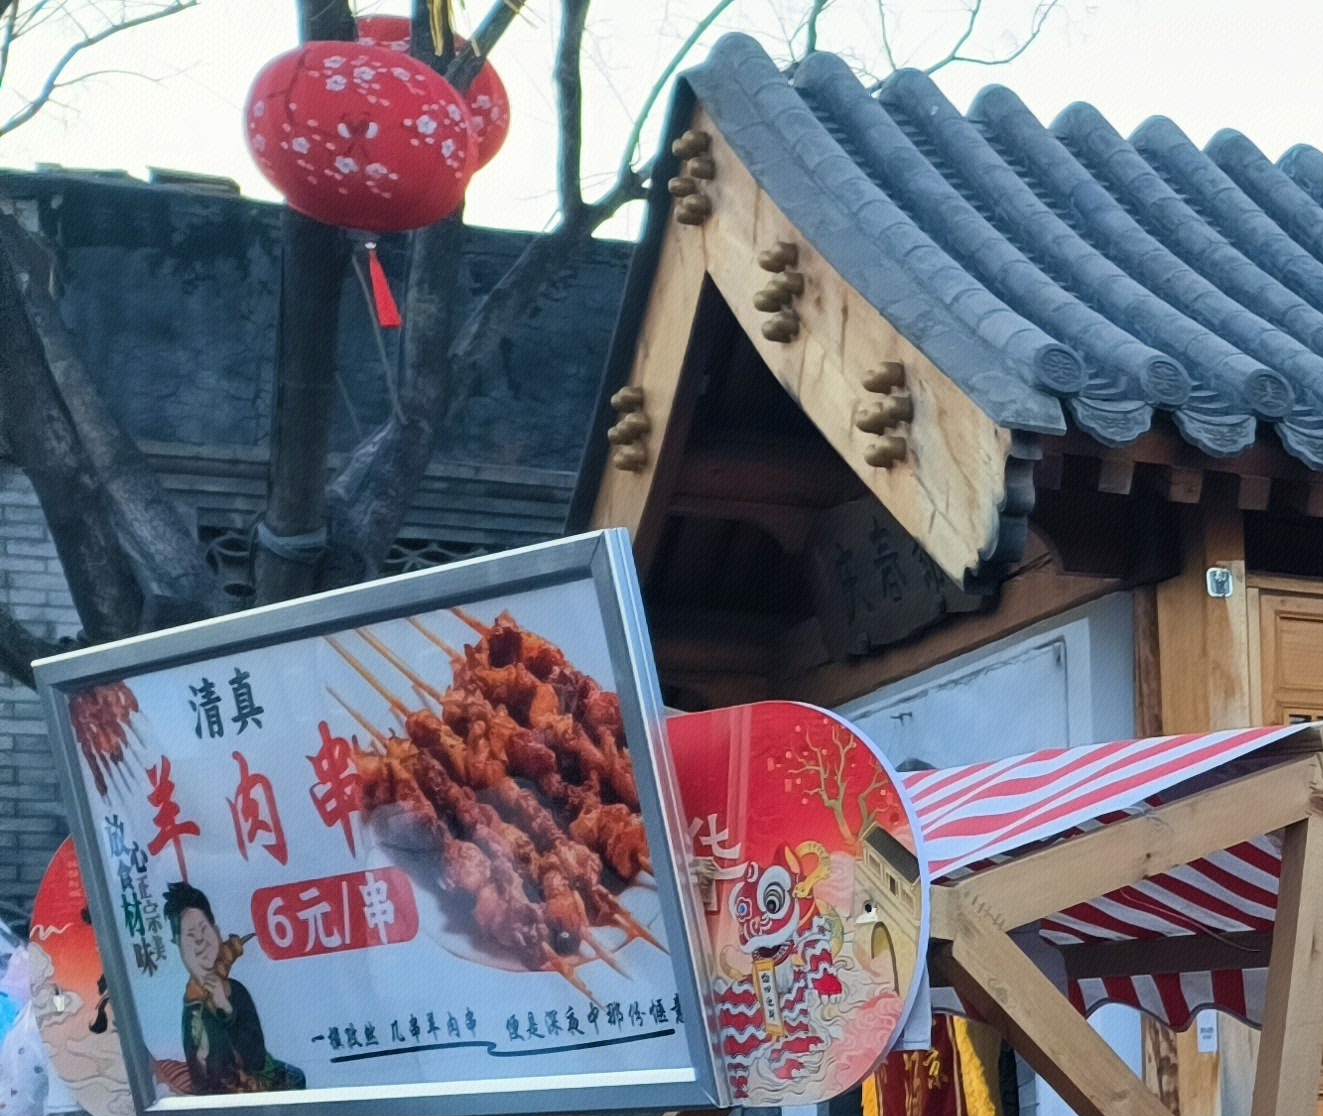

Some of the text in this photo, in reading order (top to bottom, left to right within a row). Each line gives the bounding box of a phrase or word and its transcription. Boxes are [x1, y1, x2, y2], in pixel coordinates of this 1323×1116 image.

[187, 666, 265, 740] 清真
[145, 719, 364, 884] 羊肉串
[266, 871, 396, 953] 6元/串
